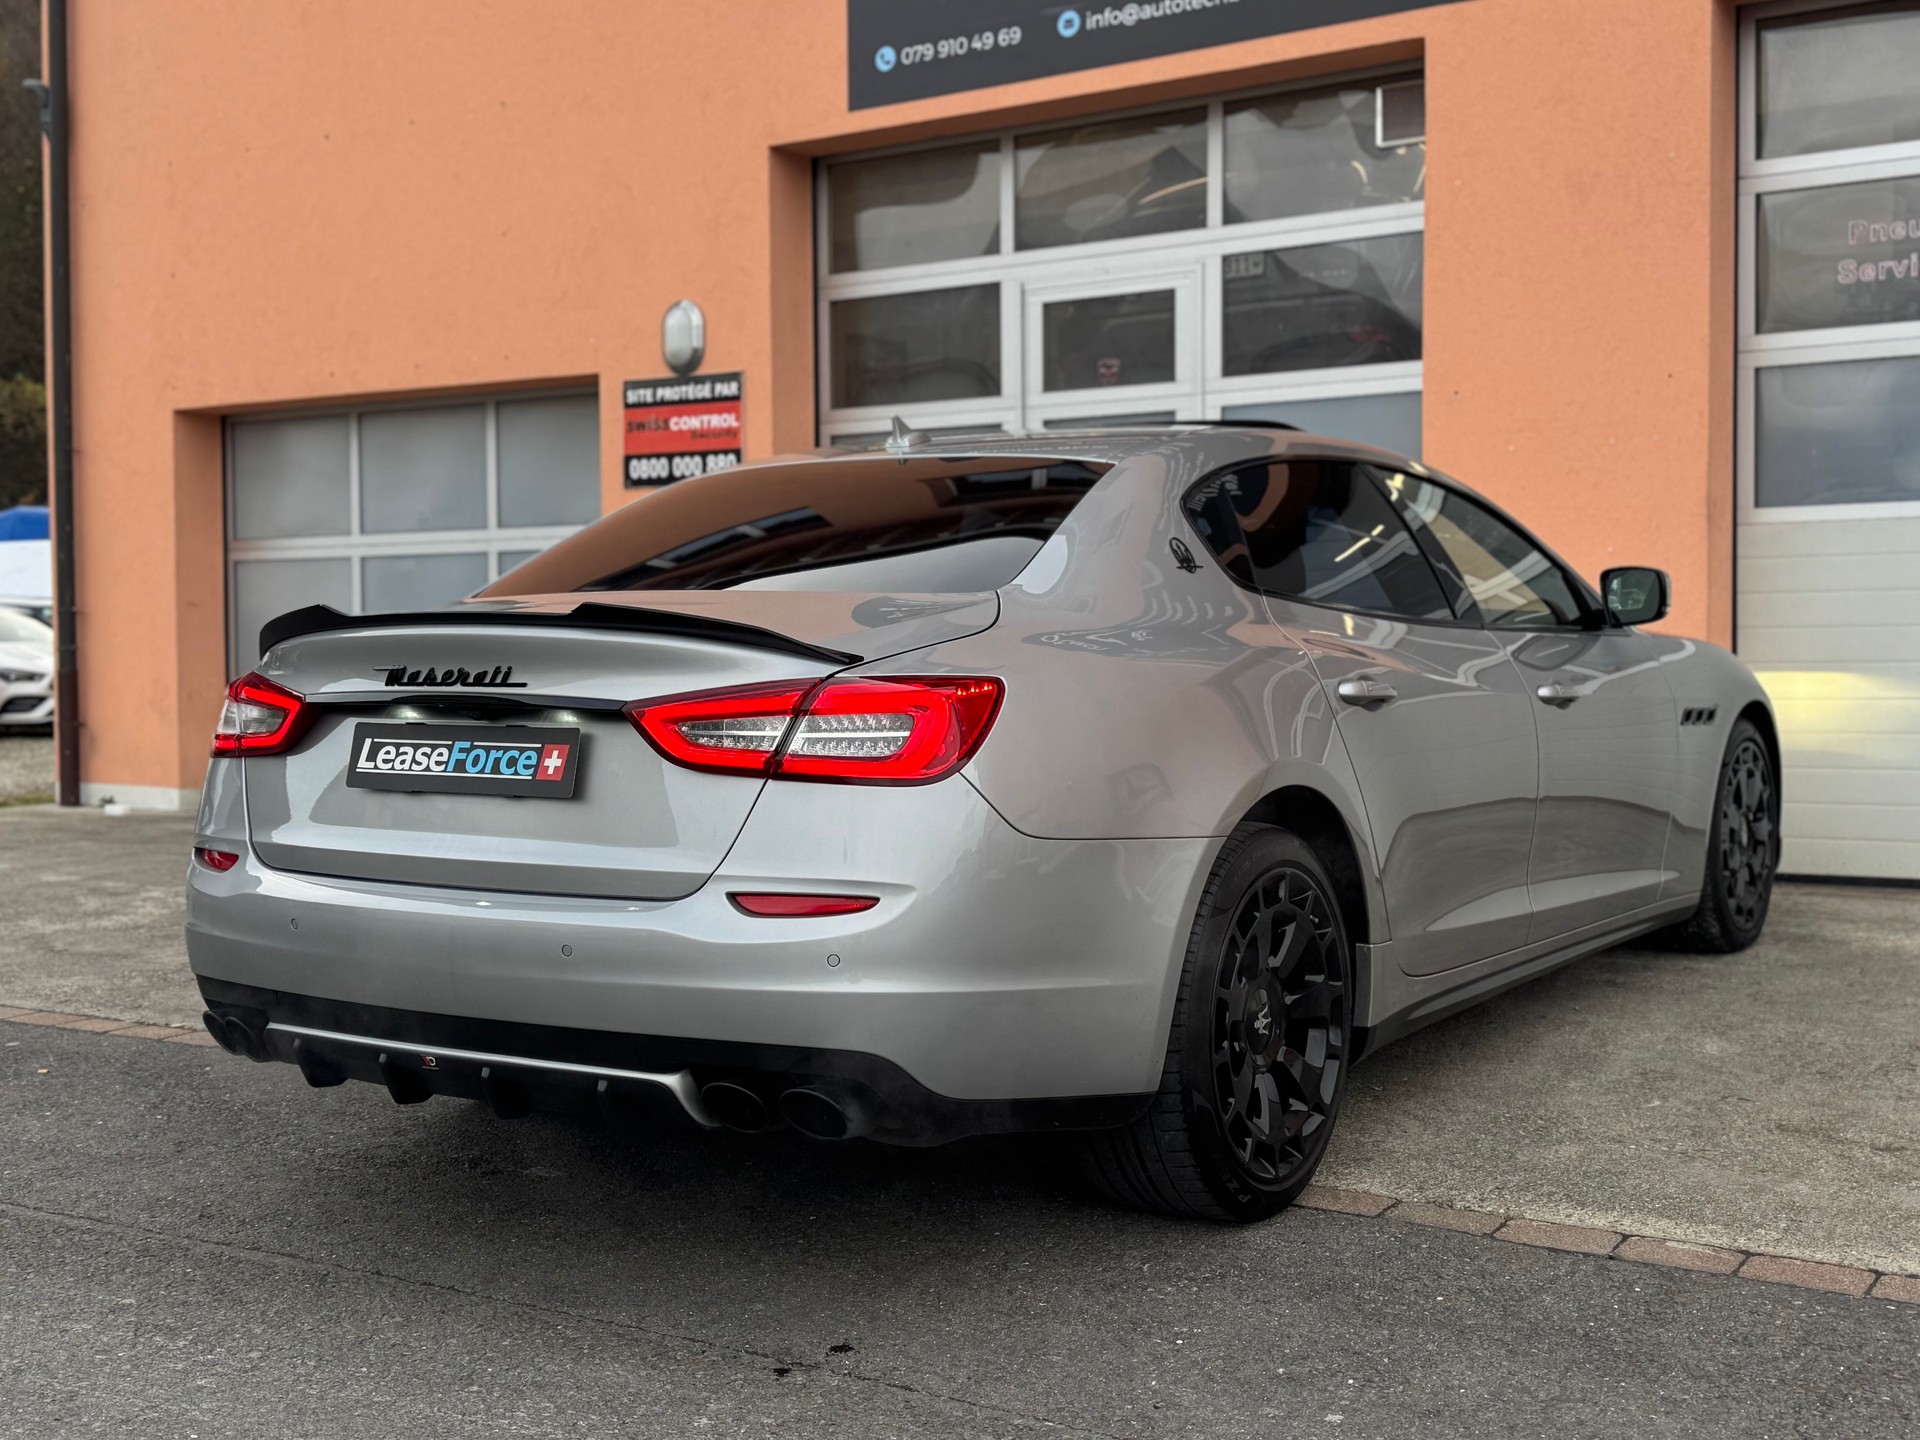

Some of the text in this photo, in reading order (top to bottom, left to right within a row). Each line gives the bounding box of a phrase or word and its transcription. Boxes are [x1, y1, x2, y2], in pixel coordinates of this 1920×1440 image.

[900, 26, 1022, 65] 079 910 49 69
[626, 380, 739, 404] SITE PROTÉGÉ PAR
[628, 457, 670, 480] 0800
[671, 455, 703, 478] 000
[373, 665, 528, 688] Maserati
[357, 738, 537, 776] LeaseForce
